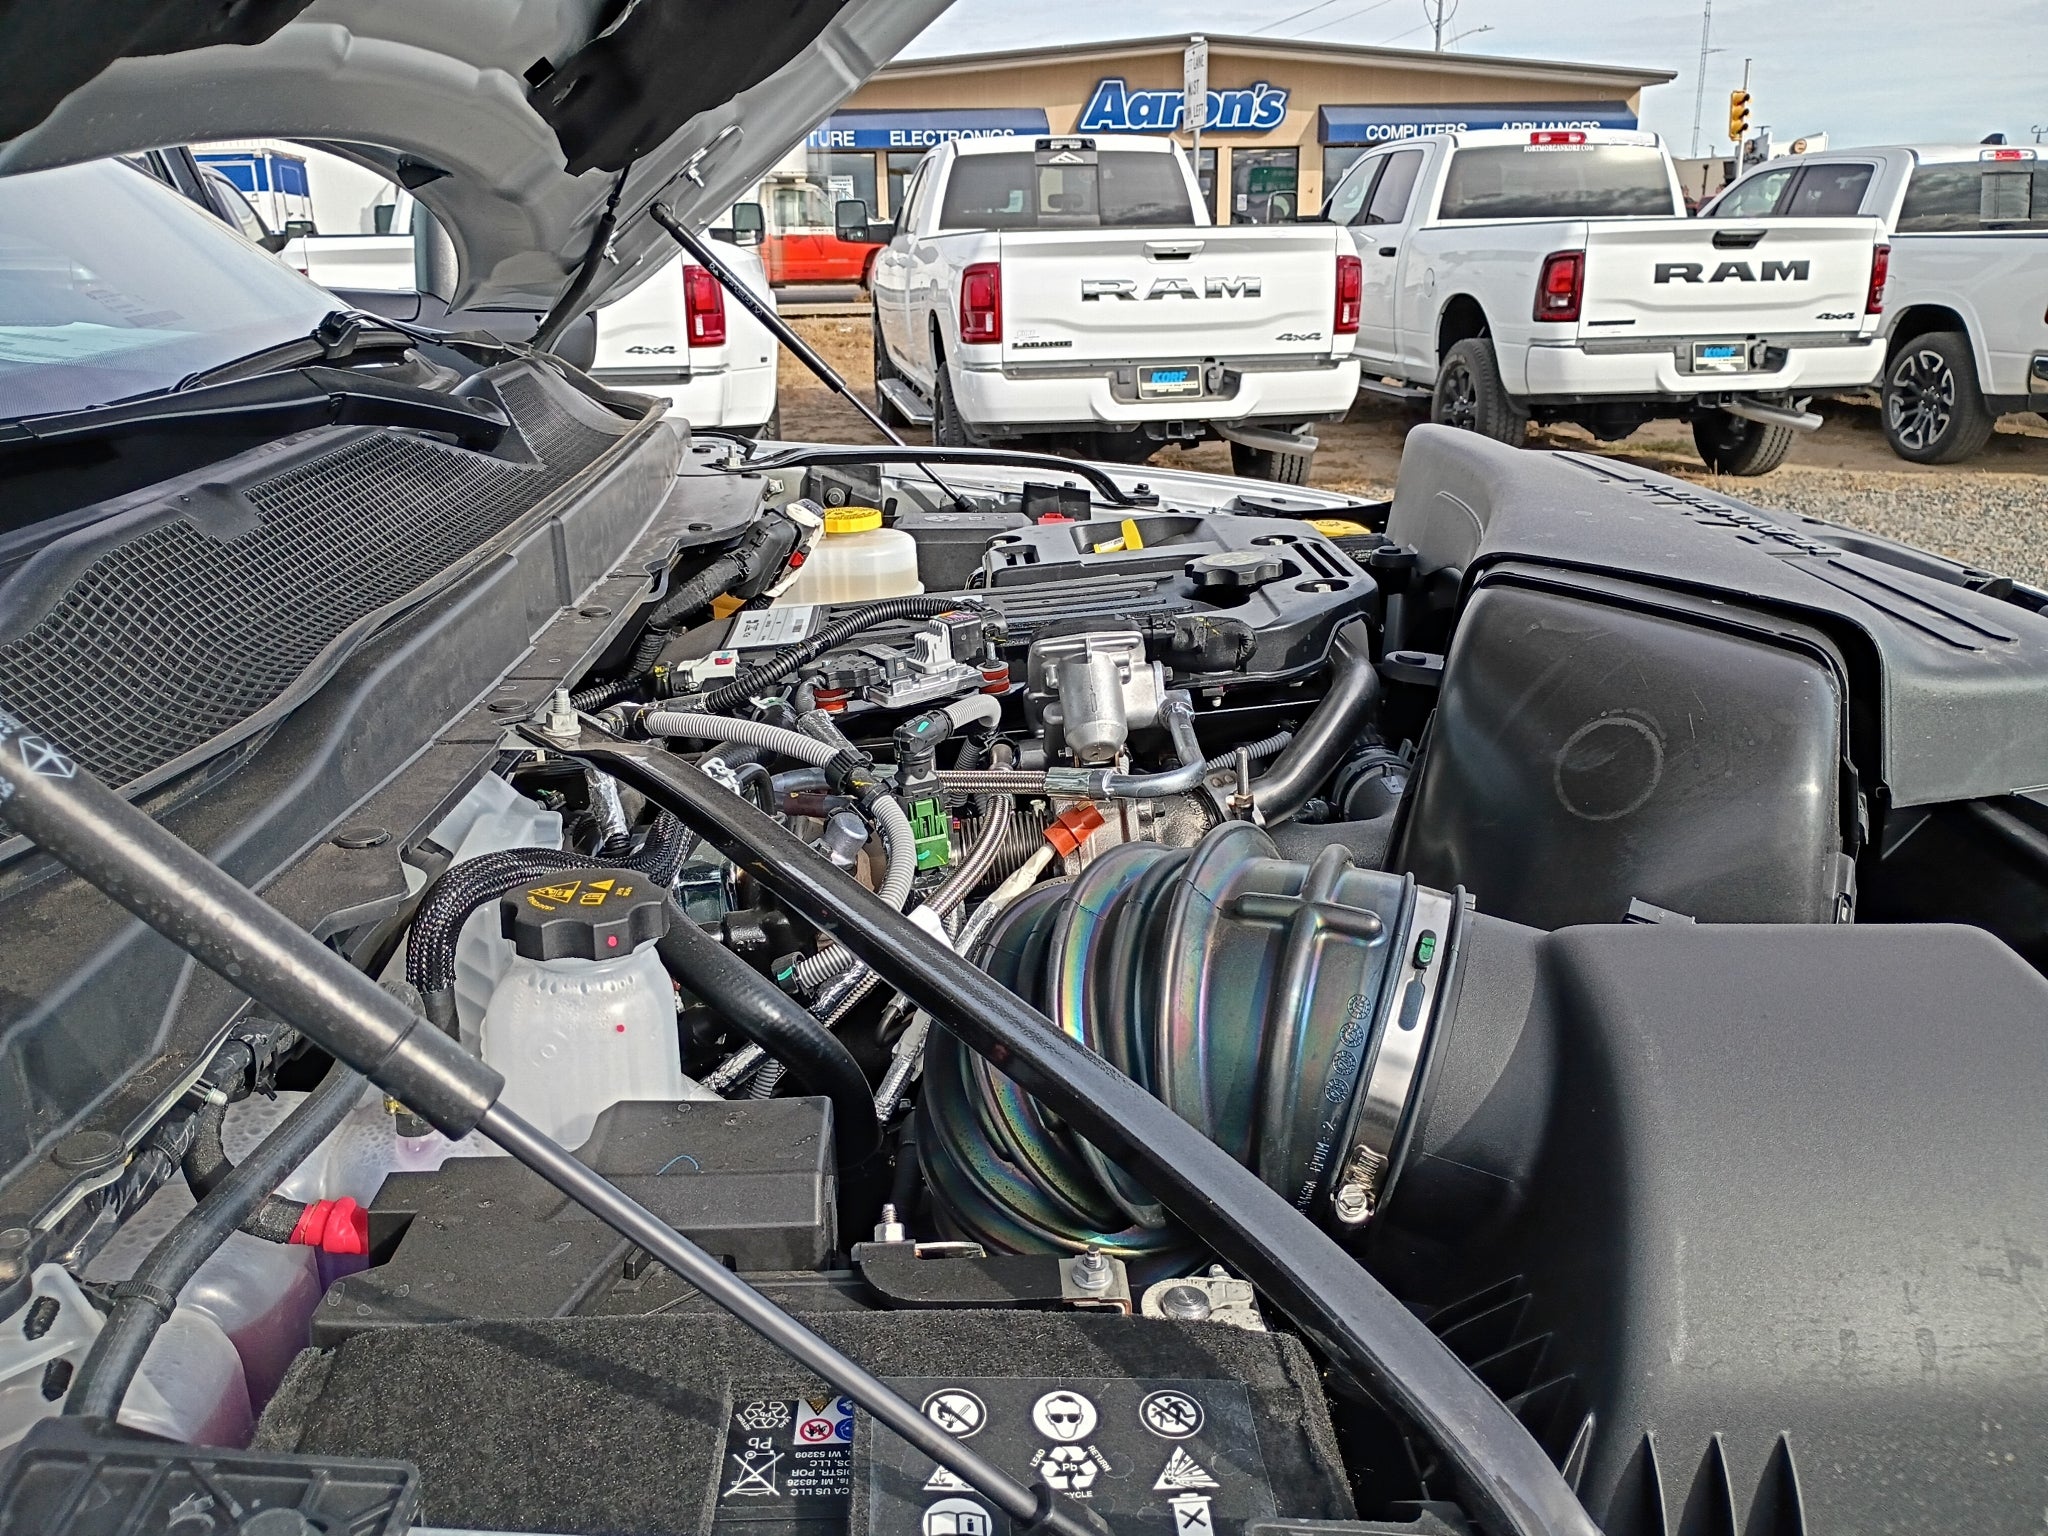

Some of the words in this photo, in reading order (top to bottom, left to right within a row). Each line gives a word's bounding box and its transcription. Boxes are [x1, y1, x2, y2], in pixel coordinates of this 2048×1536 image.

[1366, 122, 1468, 140] COMPUTERS
[1653, 260, 1811, 284] RAM
[1081, 275, 1262, 302] RAM
[1275, 332, 1323, 342] 4x4
[625, 345, 678, 355] 4x4
[1012, 340, 1073, 350] LARAMIE
[1150, 370, 1189, 383] KORF
[748, 1437, 773, 1449] Pb
[1029, 1448, 1046, 1467] LEAD
[1087, 1445, 1112, 1472] RETURN
[1062, 1463, 1078, 1471] Pb
[791, 1469, 816, 1477] POR
[787, 1479, 818, 1487] 48326
[790, 1488, 813, 1496] LLC
[1063, 1490, 1093, 1499] YCLE
